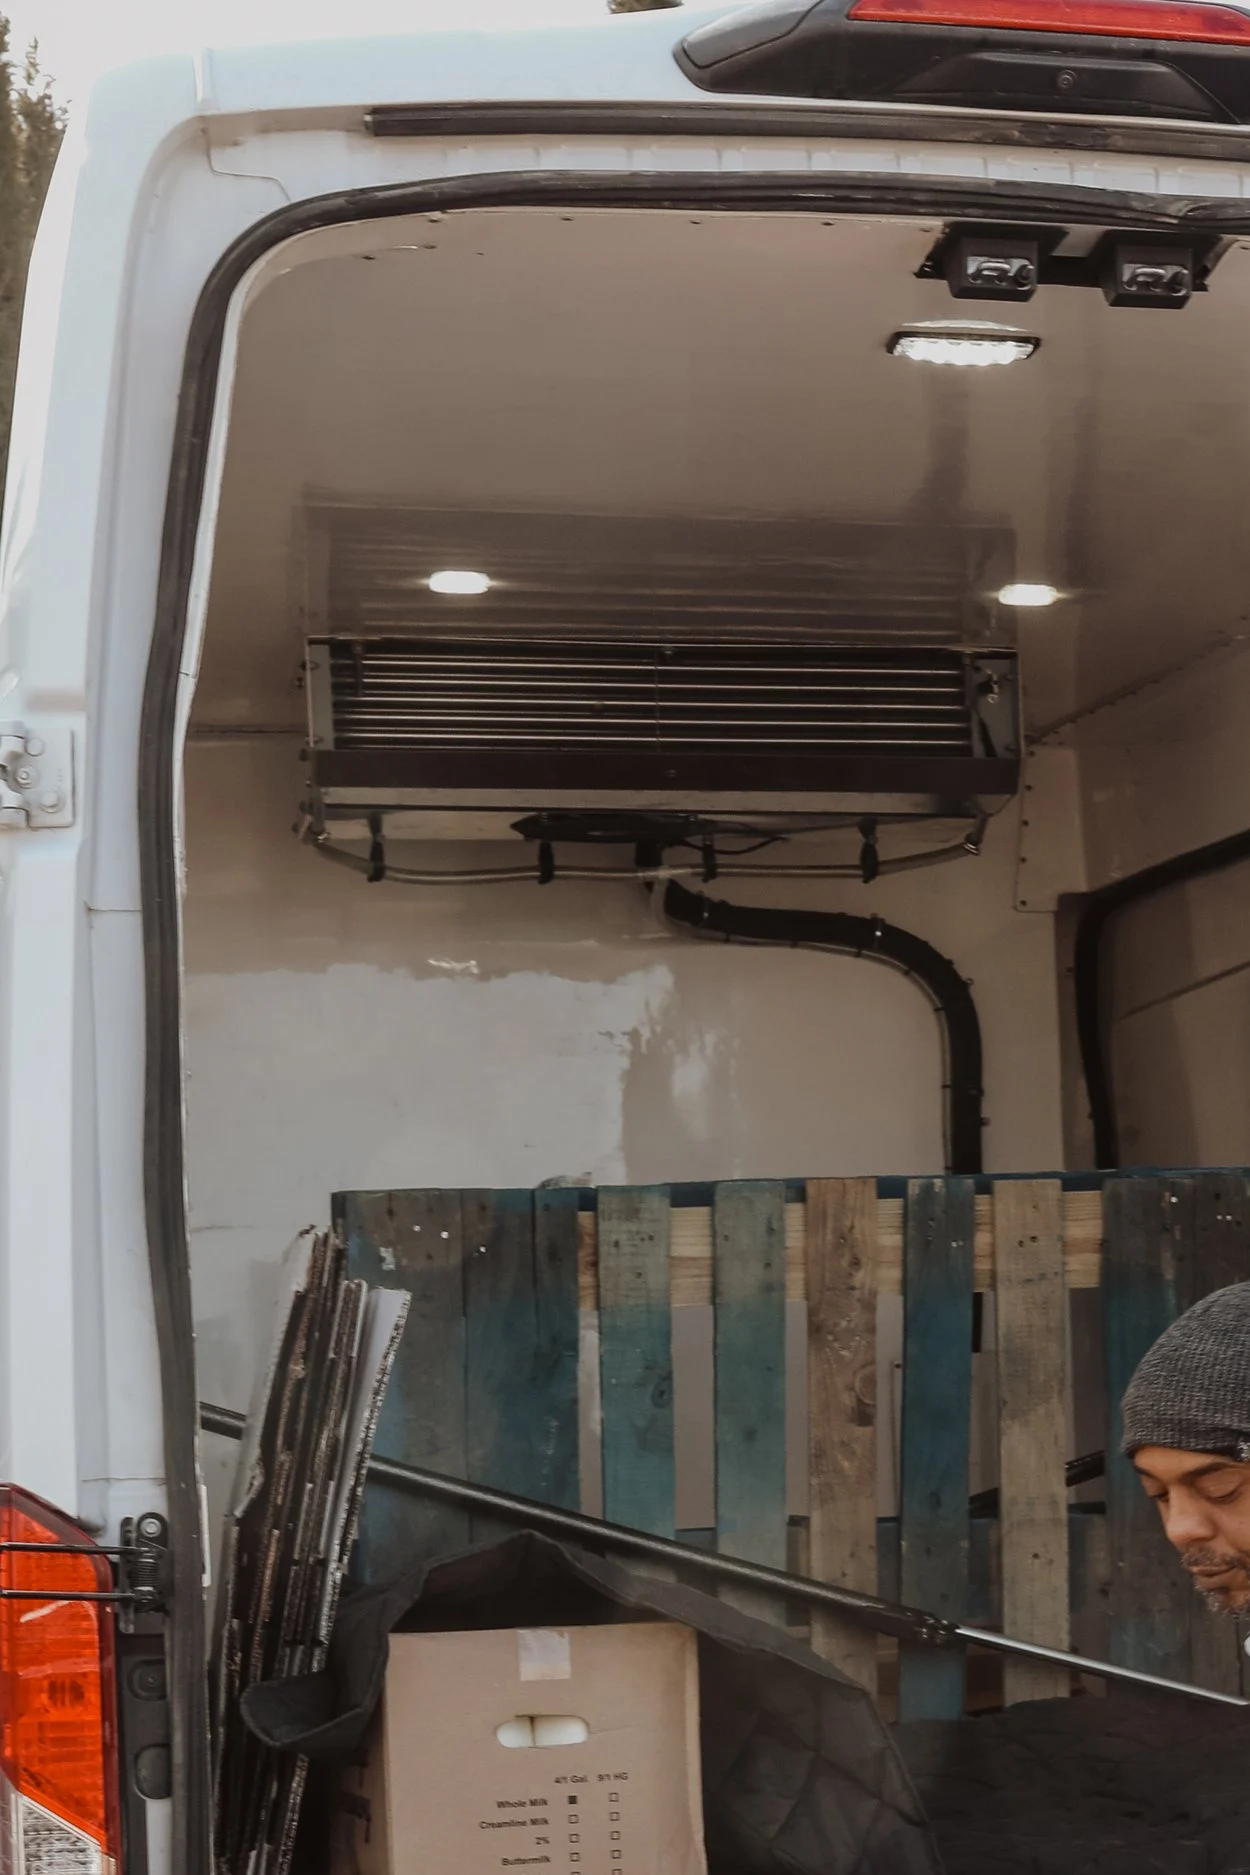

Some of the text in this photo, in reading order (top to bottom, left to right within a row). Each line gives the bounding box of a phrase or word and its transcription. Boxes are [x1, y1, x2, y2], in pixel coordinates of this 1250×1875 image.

[496, 1798, 548, 1809] Whole Milk
[479, 1817, 549, 1829] Creamline Milk
[535, 1836, 550, 1845] 2%
[501, 1855, 551, 1866] Buttermilk
